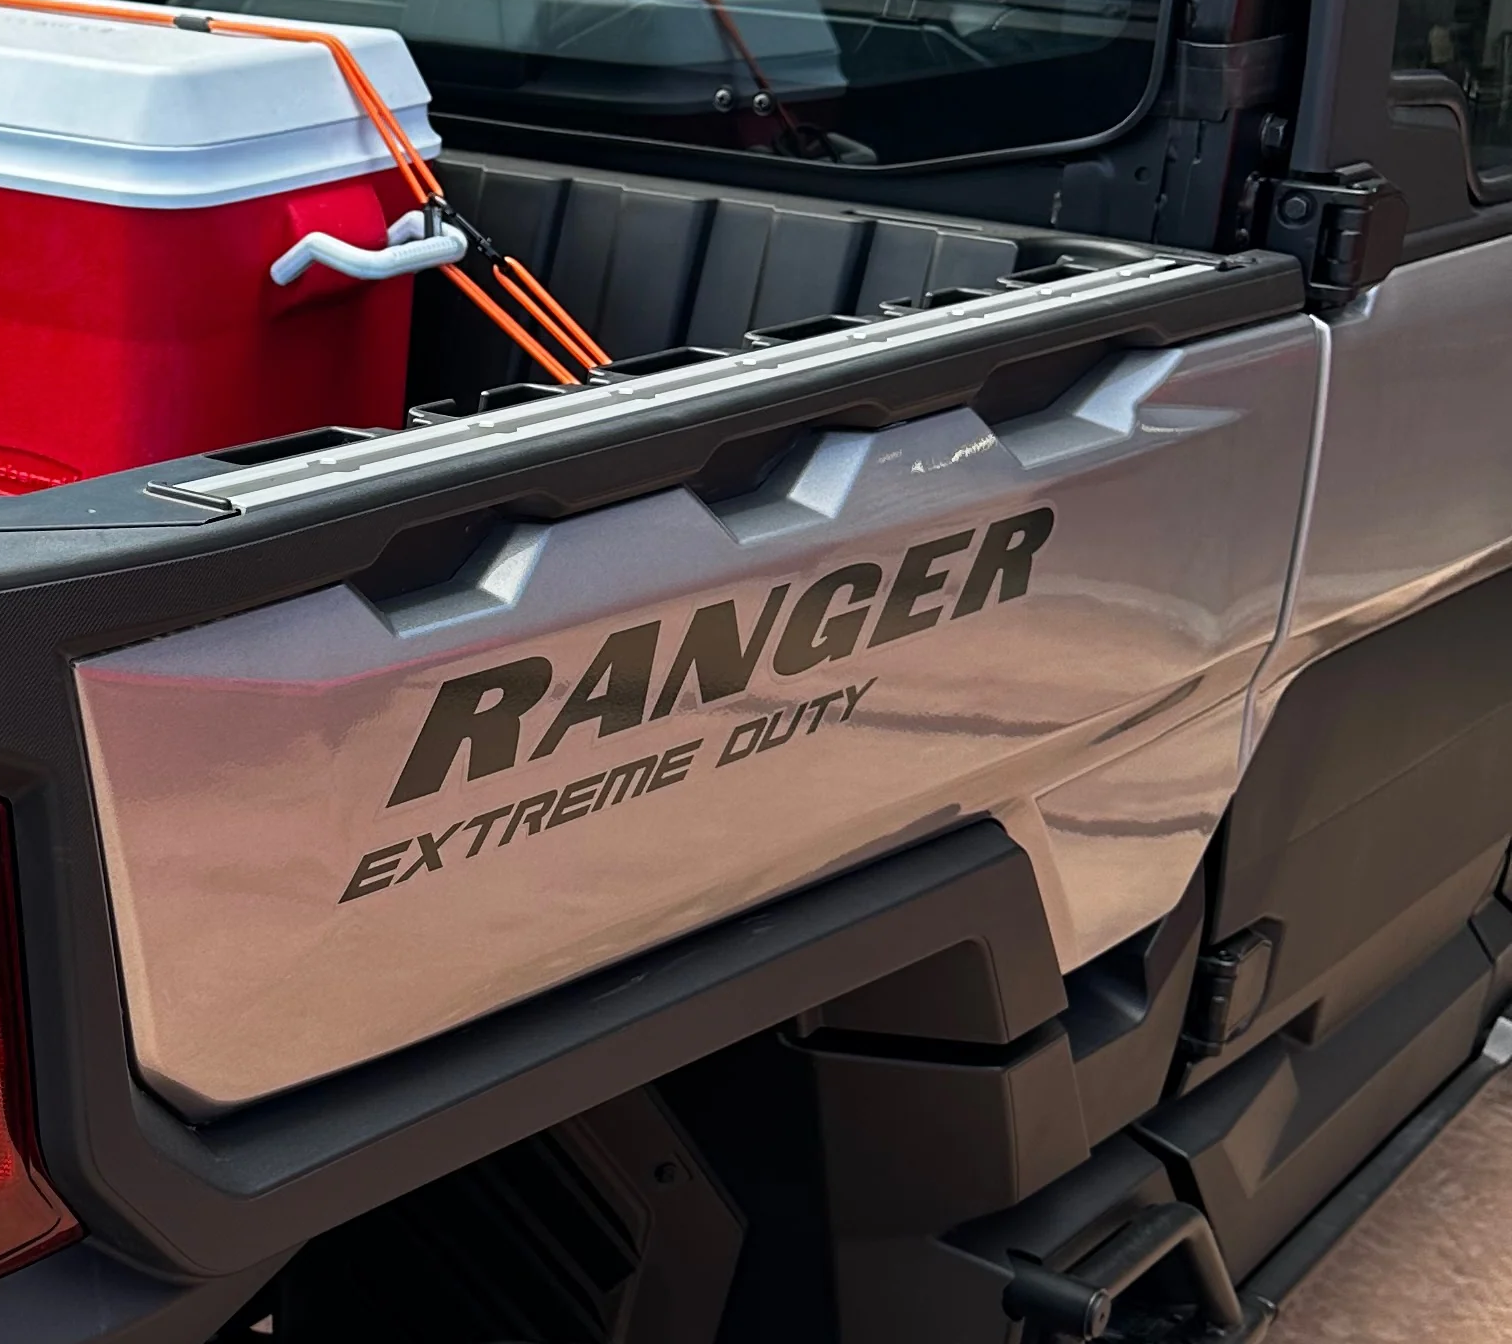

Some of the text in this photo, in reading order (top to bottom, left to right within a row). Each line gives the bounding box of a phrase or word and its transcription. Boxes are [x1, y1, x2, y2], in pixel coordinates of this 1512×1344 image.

[387, 507, 1055, 808] RANGER
[338, 676, 878, 904] EXTREME DUTY
